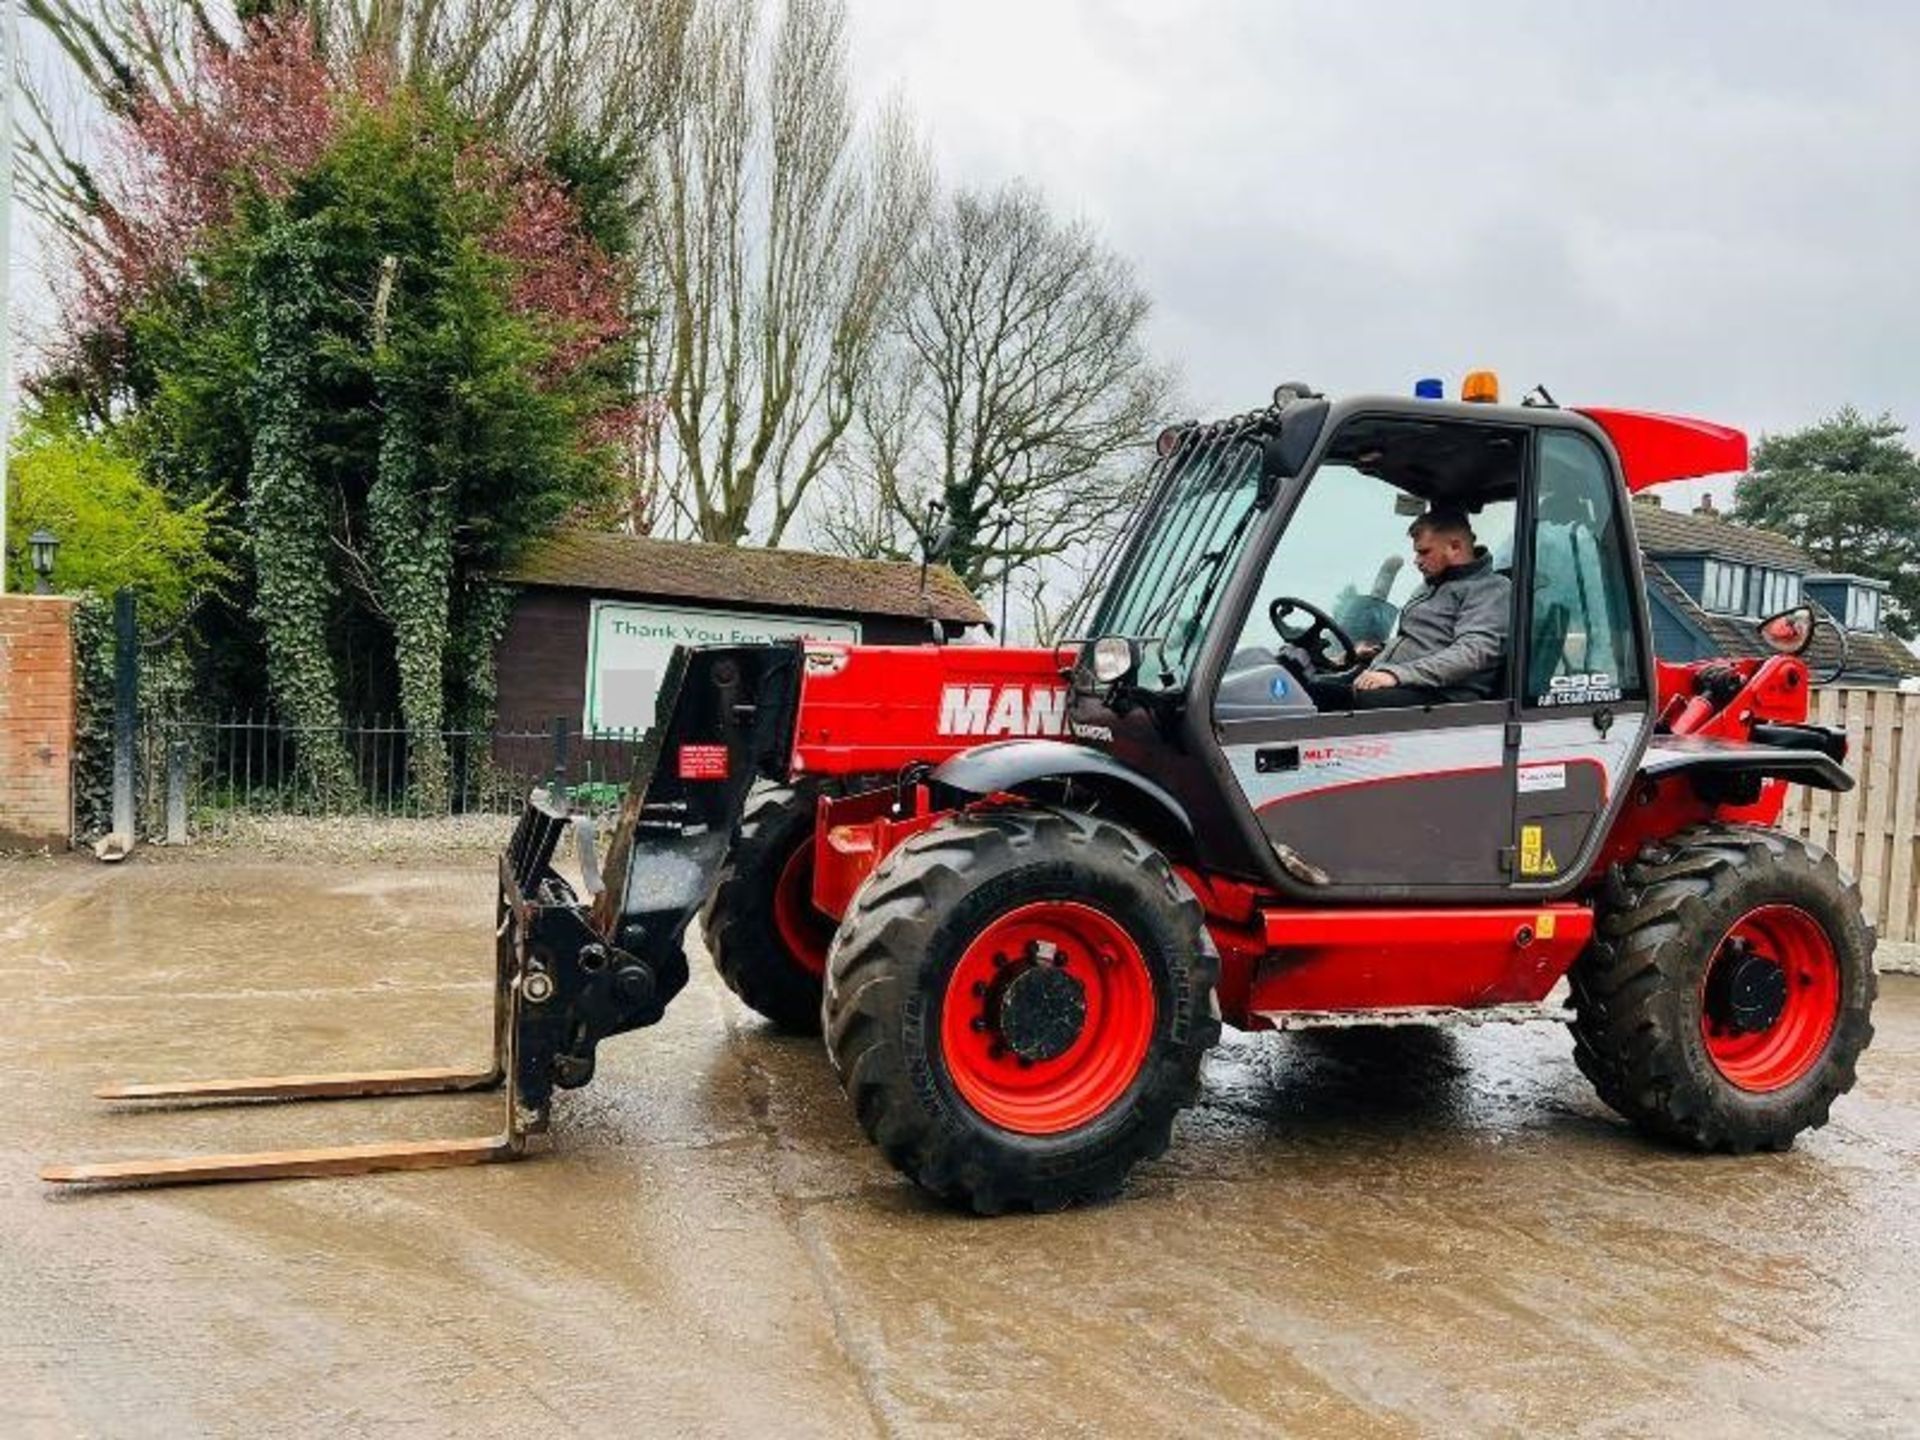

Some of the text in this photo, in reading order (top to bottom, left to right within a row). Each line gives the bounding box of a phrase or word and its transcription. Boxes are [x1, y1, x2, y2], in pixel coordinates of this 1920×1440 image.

[613, 621, 677, 639] Thank
[684, 626, 723, 641] You
[731, 629, 763, 644] For
[938, 684, 1071, 736] MAN
[1302, 747, 1333, 759] MLT
